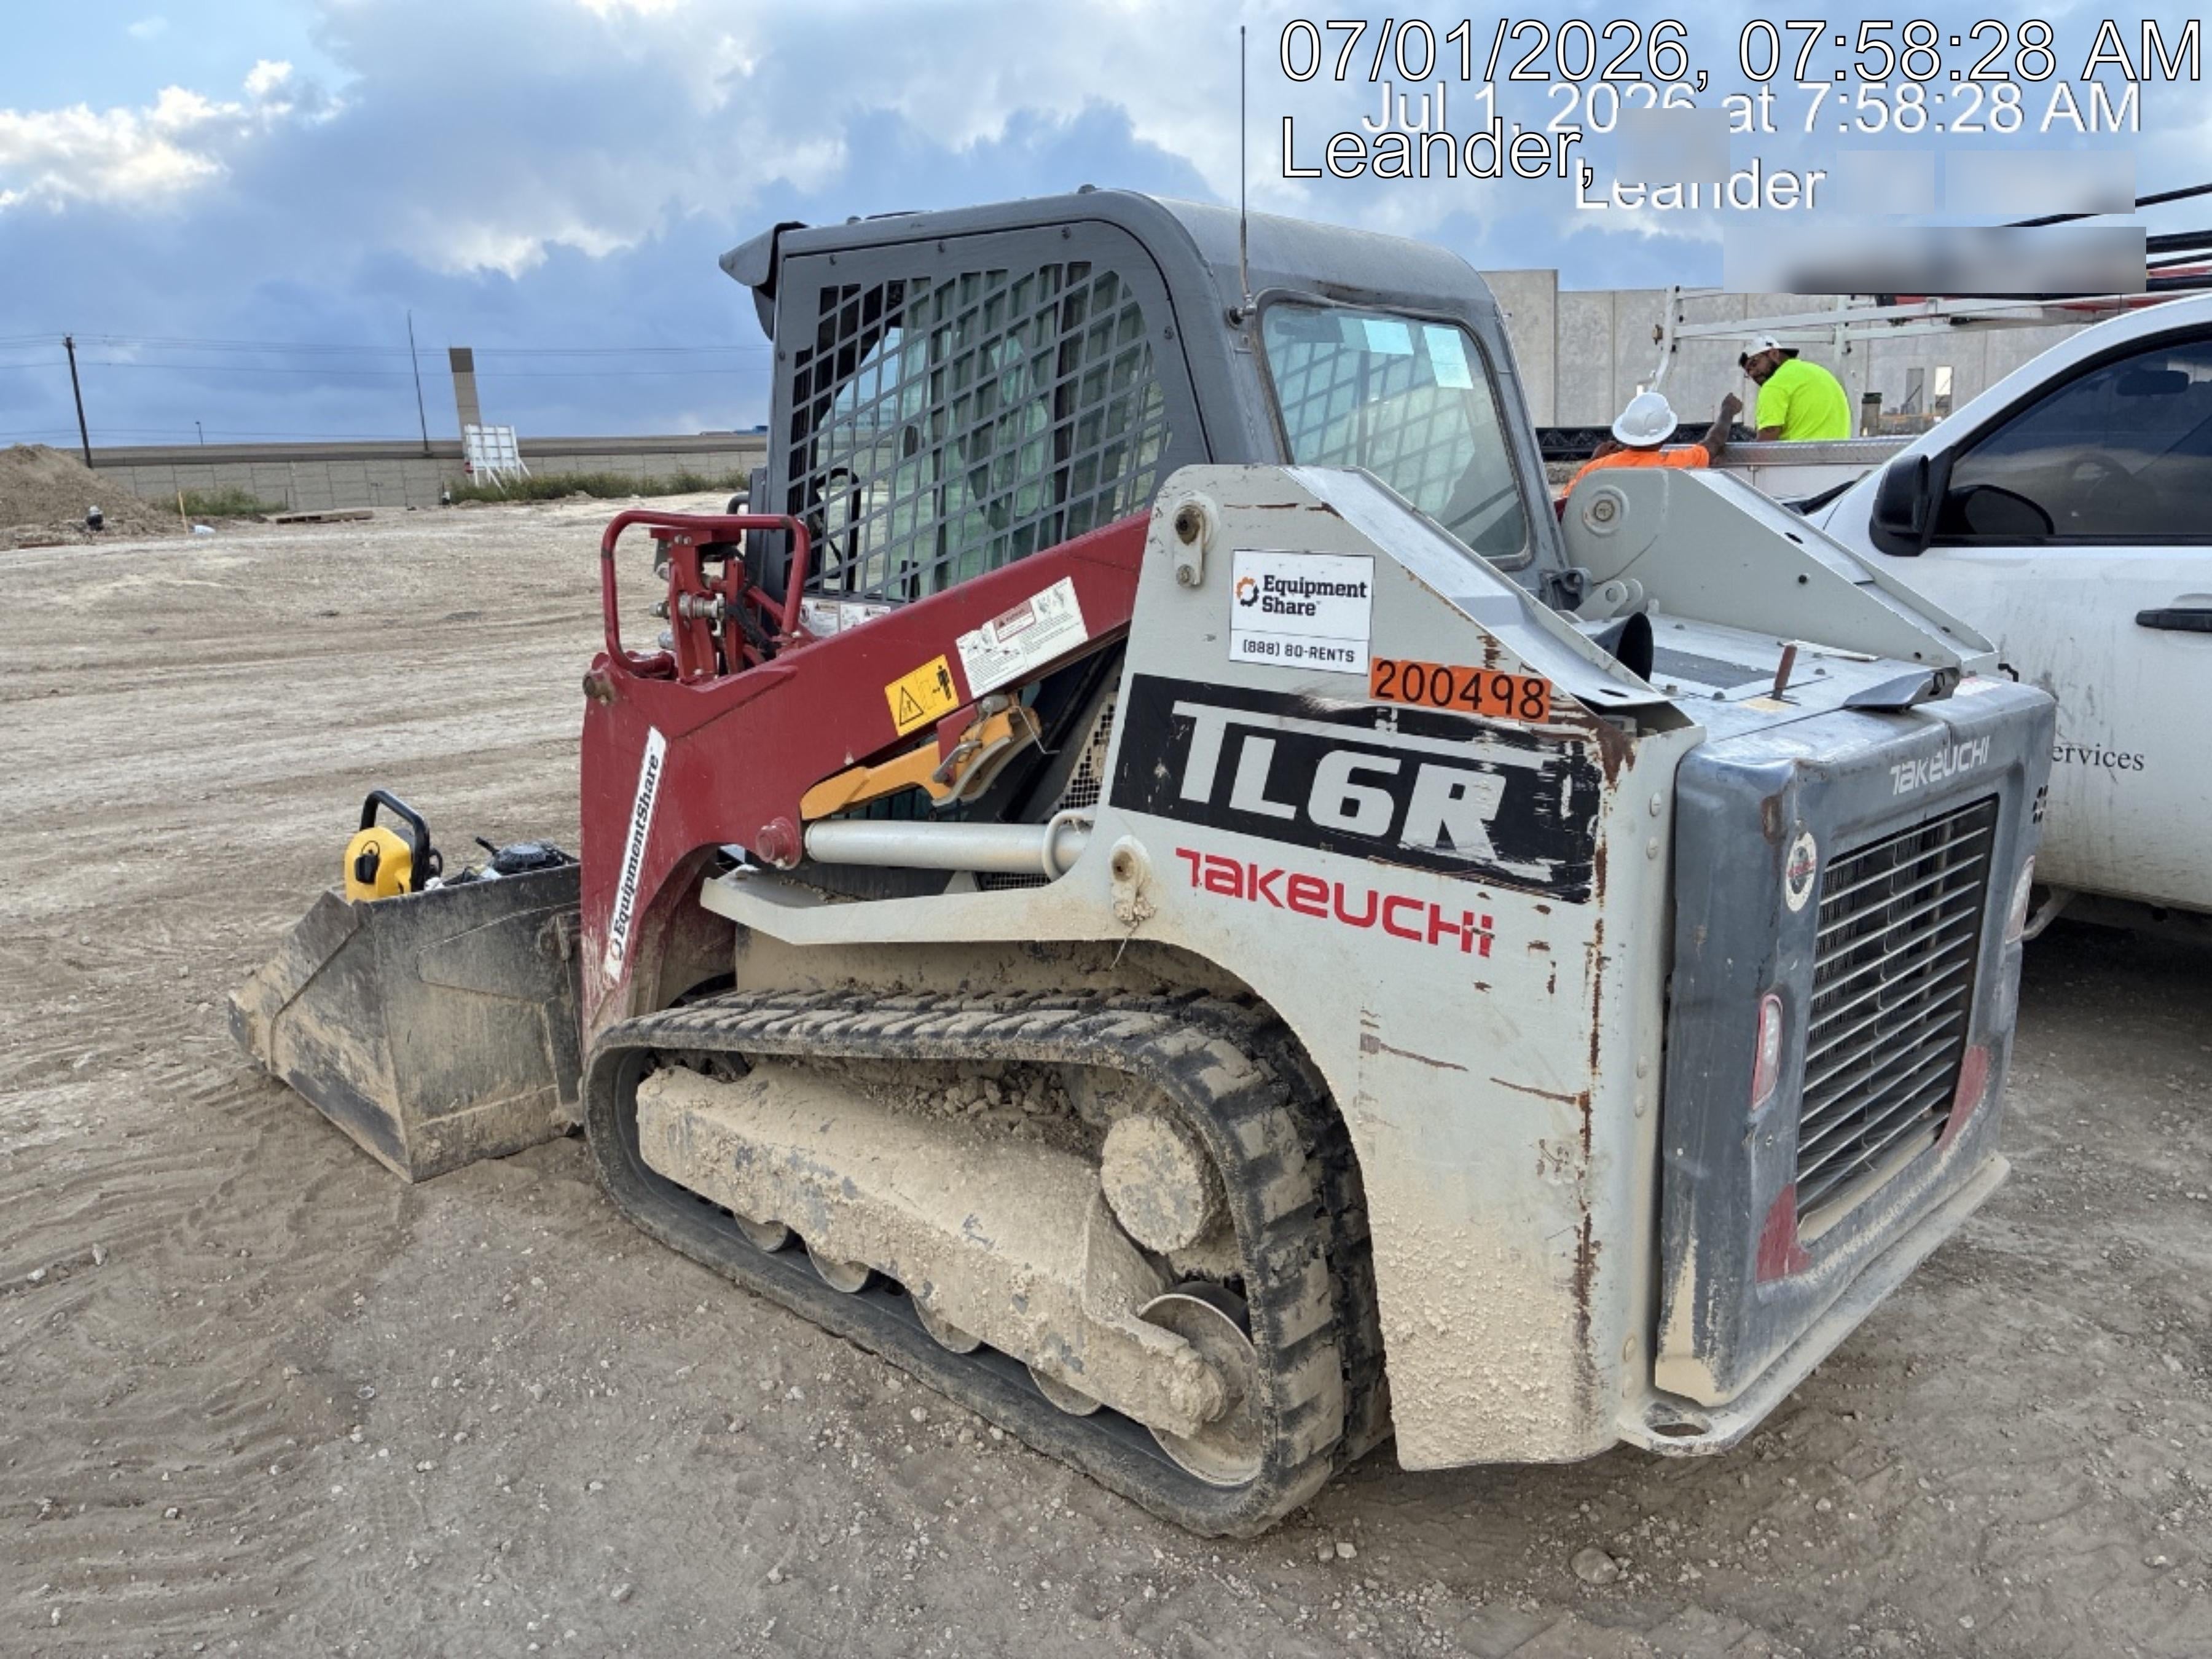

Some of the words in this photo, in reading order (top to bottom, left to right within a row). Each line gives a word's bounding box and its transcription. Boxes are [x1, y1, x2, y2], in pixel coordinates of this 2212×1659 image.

[1263, 574, 1368, 598] Equipment
[1262, 595, 1317, 616] Share
[1243, 638, 1281, 657] (888)
[1375, 659, 1545, 720] 200498
[2052, 742, 2145, 771] ervices
[1172, 700, 1558, 883] TL6R
[614, 753, 659, 938] EquipmentShare
